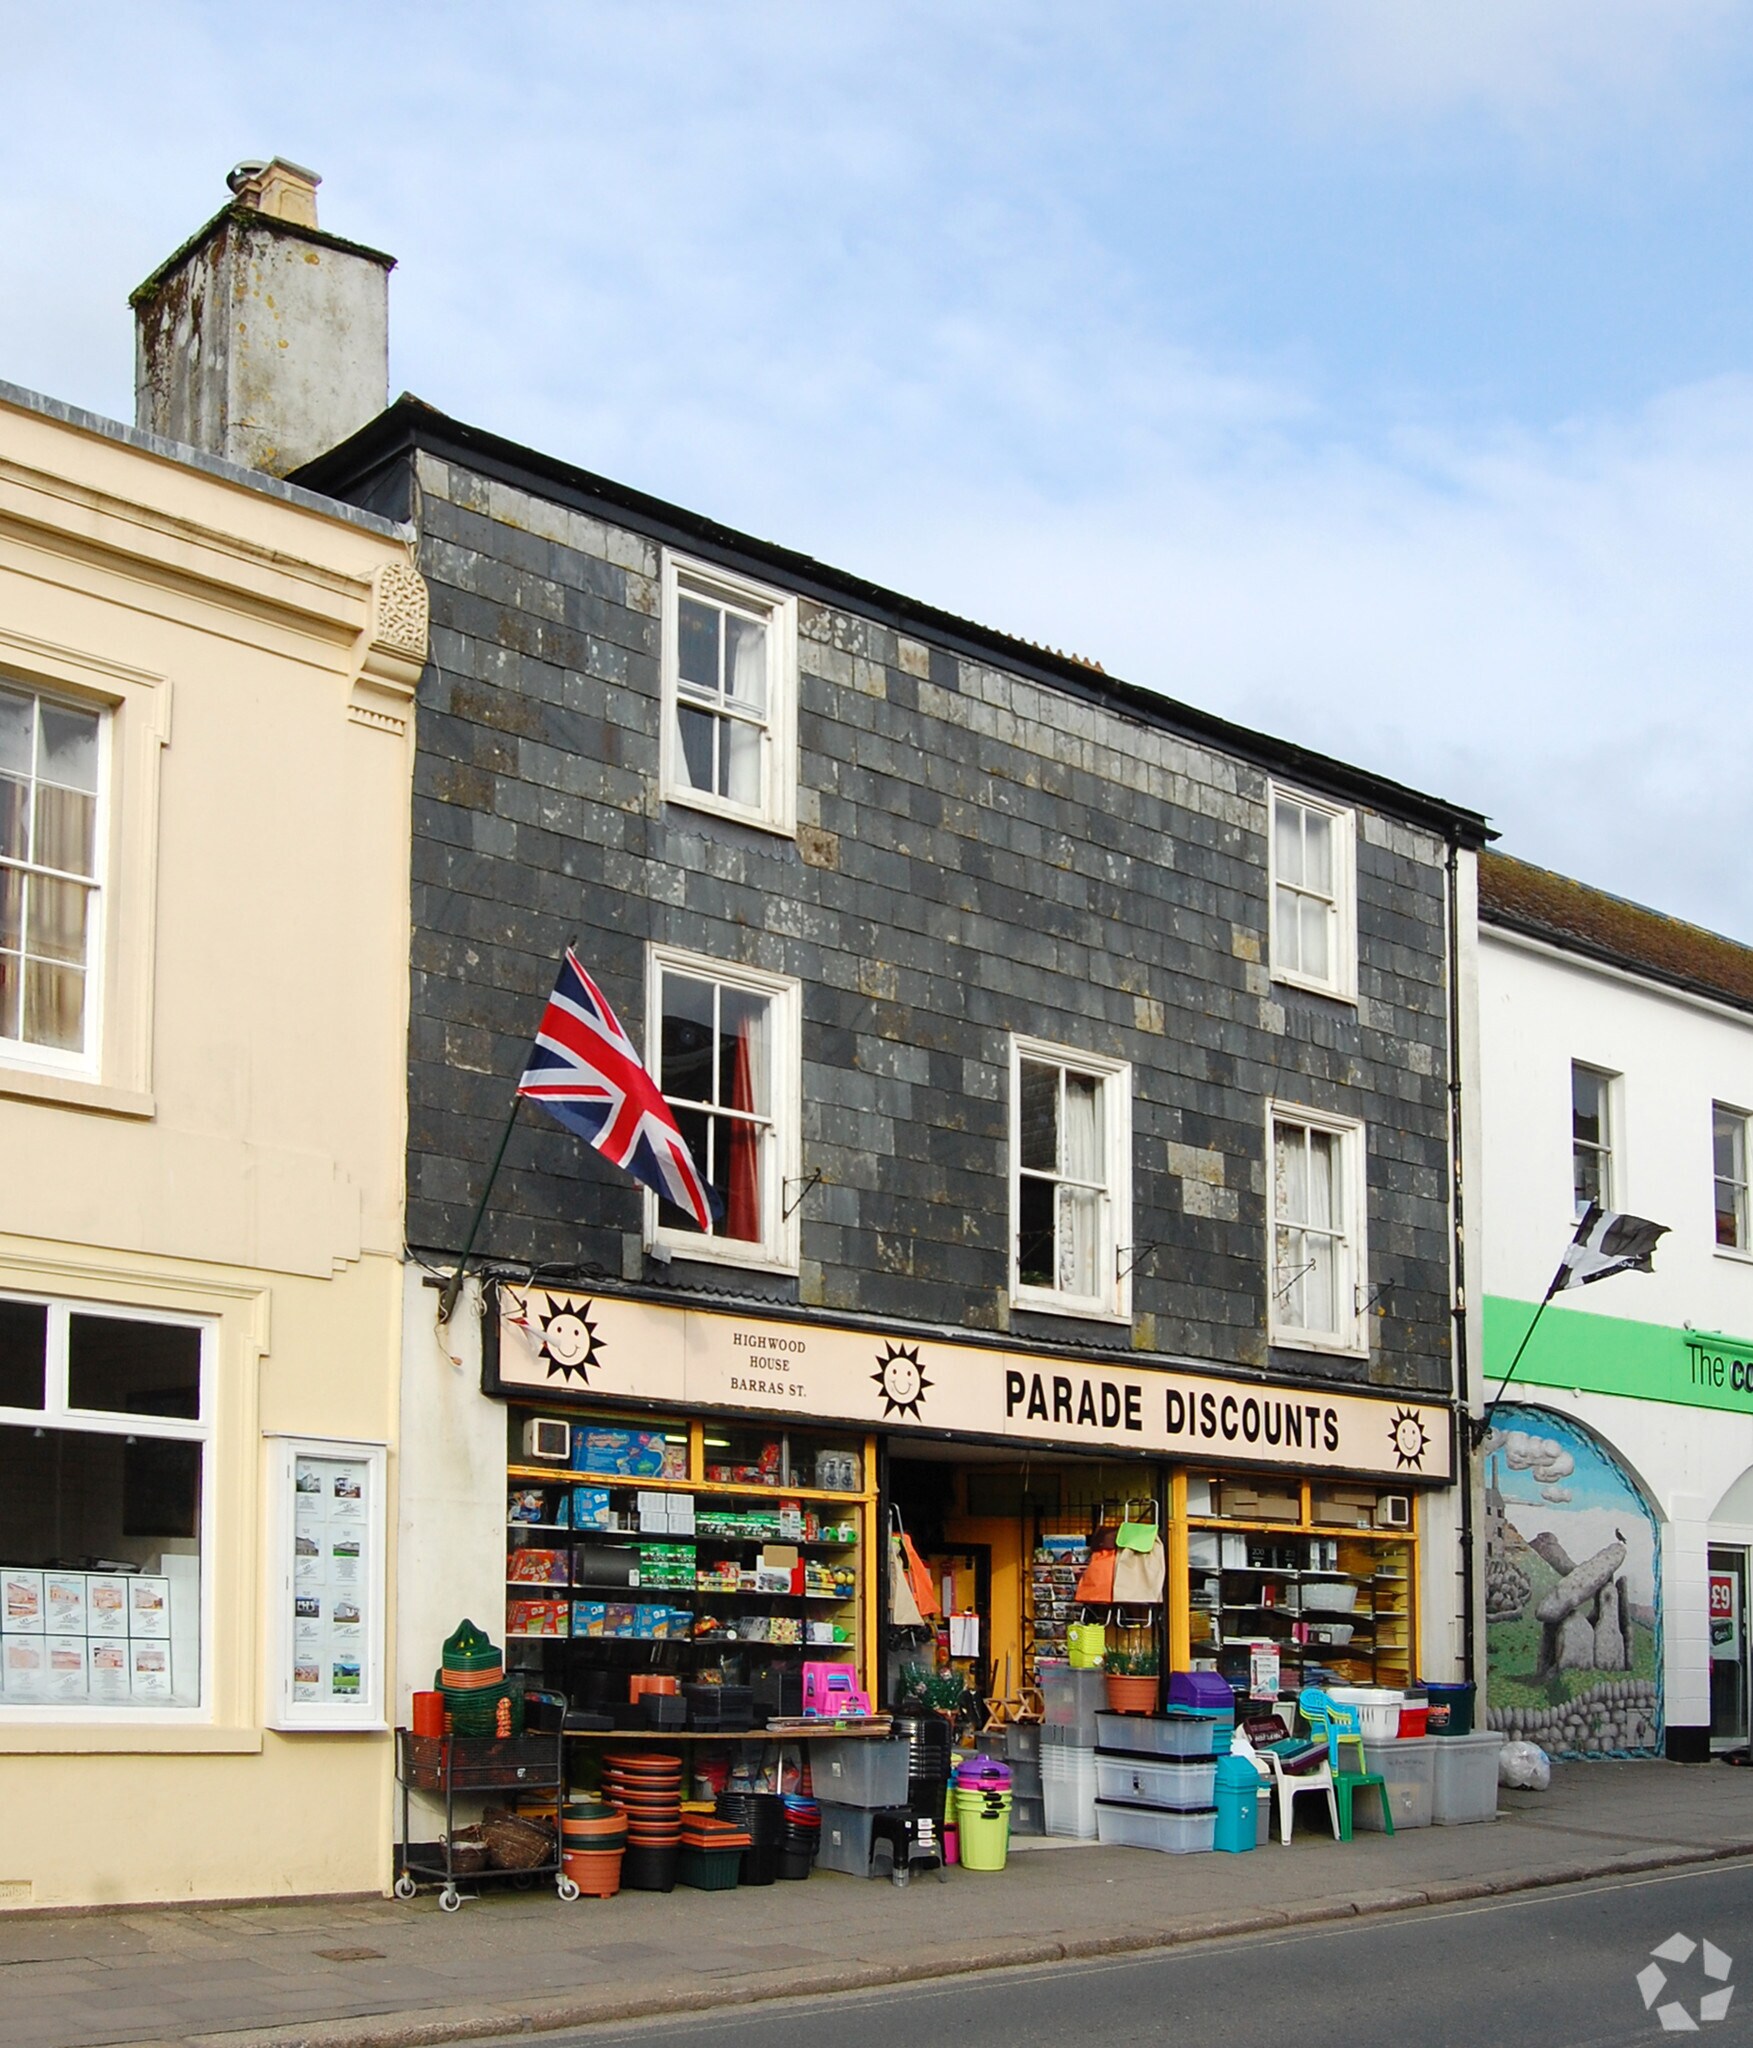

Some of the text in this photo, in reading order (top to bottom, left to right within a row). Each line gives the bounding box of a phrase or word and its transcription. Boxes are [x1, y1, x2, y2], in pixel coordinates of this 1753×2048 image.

[733, 1332, 806, 1353] HIGHWOOD
[750, 1355, 790, 1372] HOUSE
[1686, 1343, 1724, 1387] The
[731, 1377, 807, 1398] BARRAS ST.
[1005, 1369, 1339, 1451] PARADE DISCOUNTS
[1711, 1584, 1730, 1610] £9
